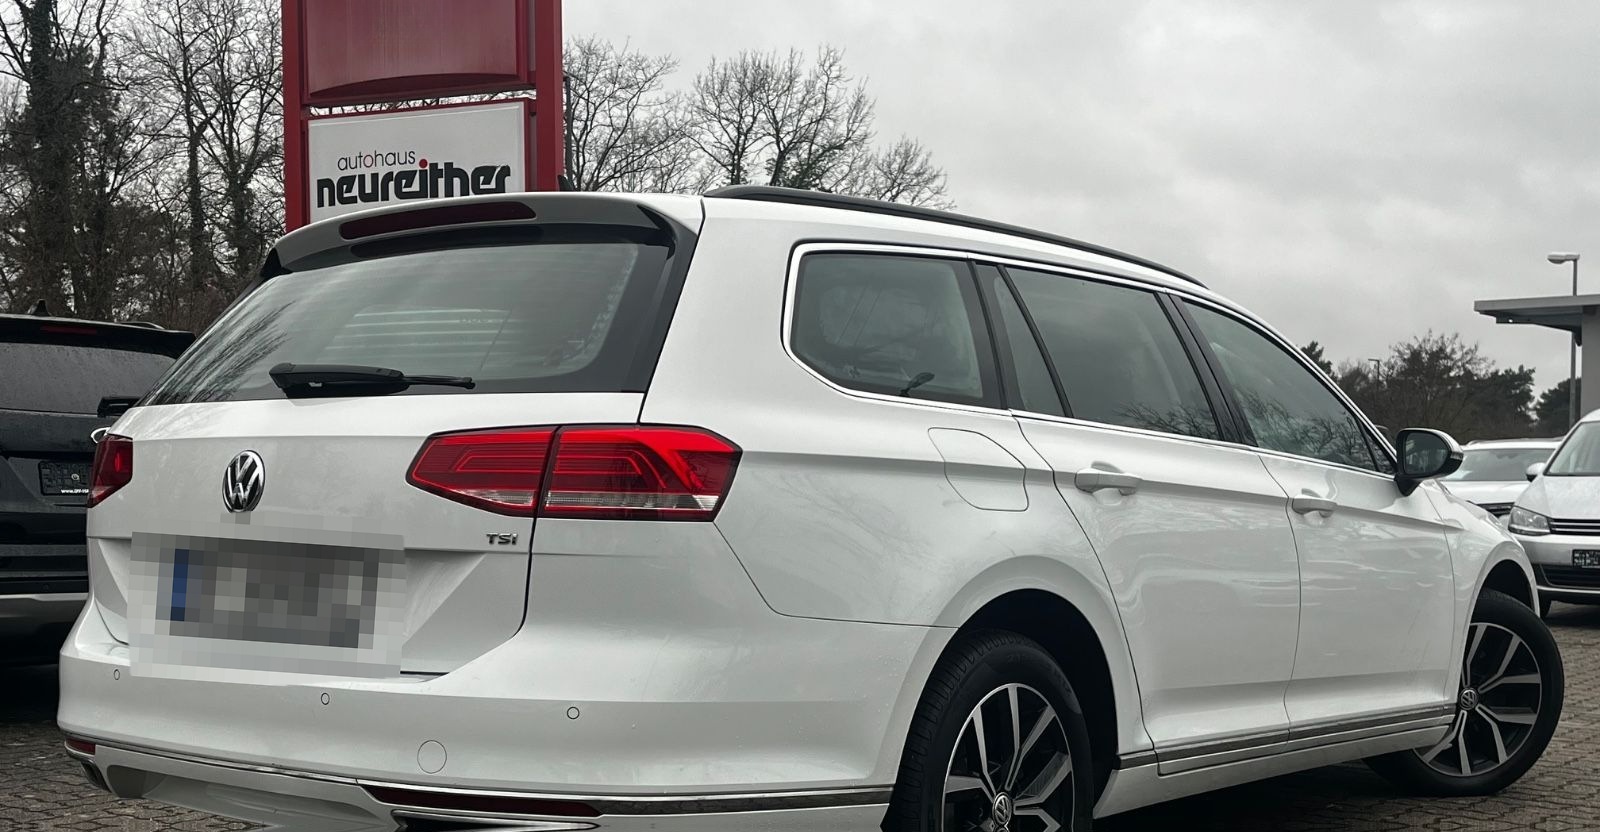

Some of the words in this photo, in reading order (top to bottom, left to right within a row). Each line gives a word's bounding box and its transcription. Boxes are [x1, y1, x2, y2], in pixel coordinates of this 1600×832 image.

[337, 149, 416, 171] autohaus
[316, 159, 511, 208] neureither
[486, 532, 518, 546] TSI
